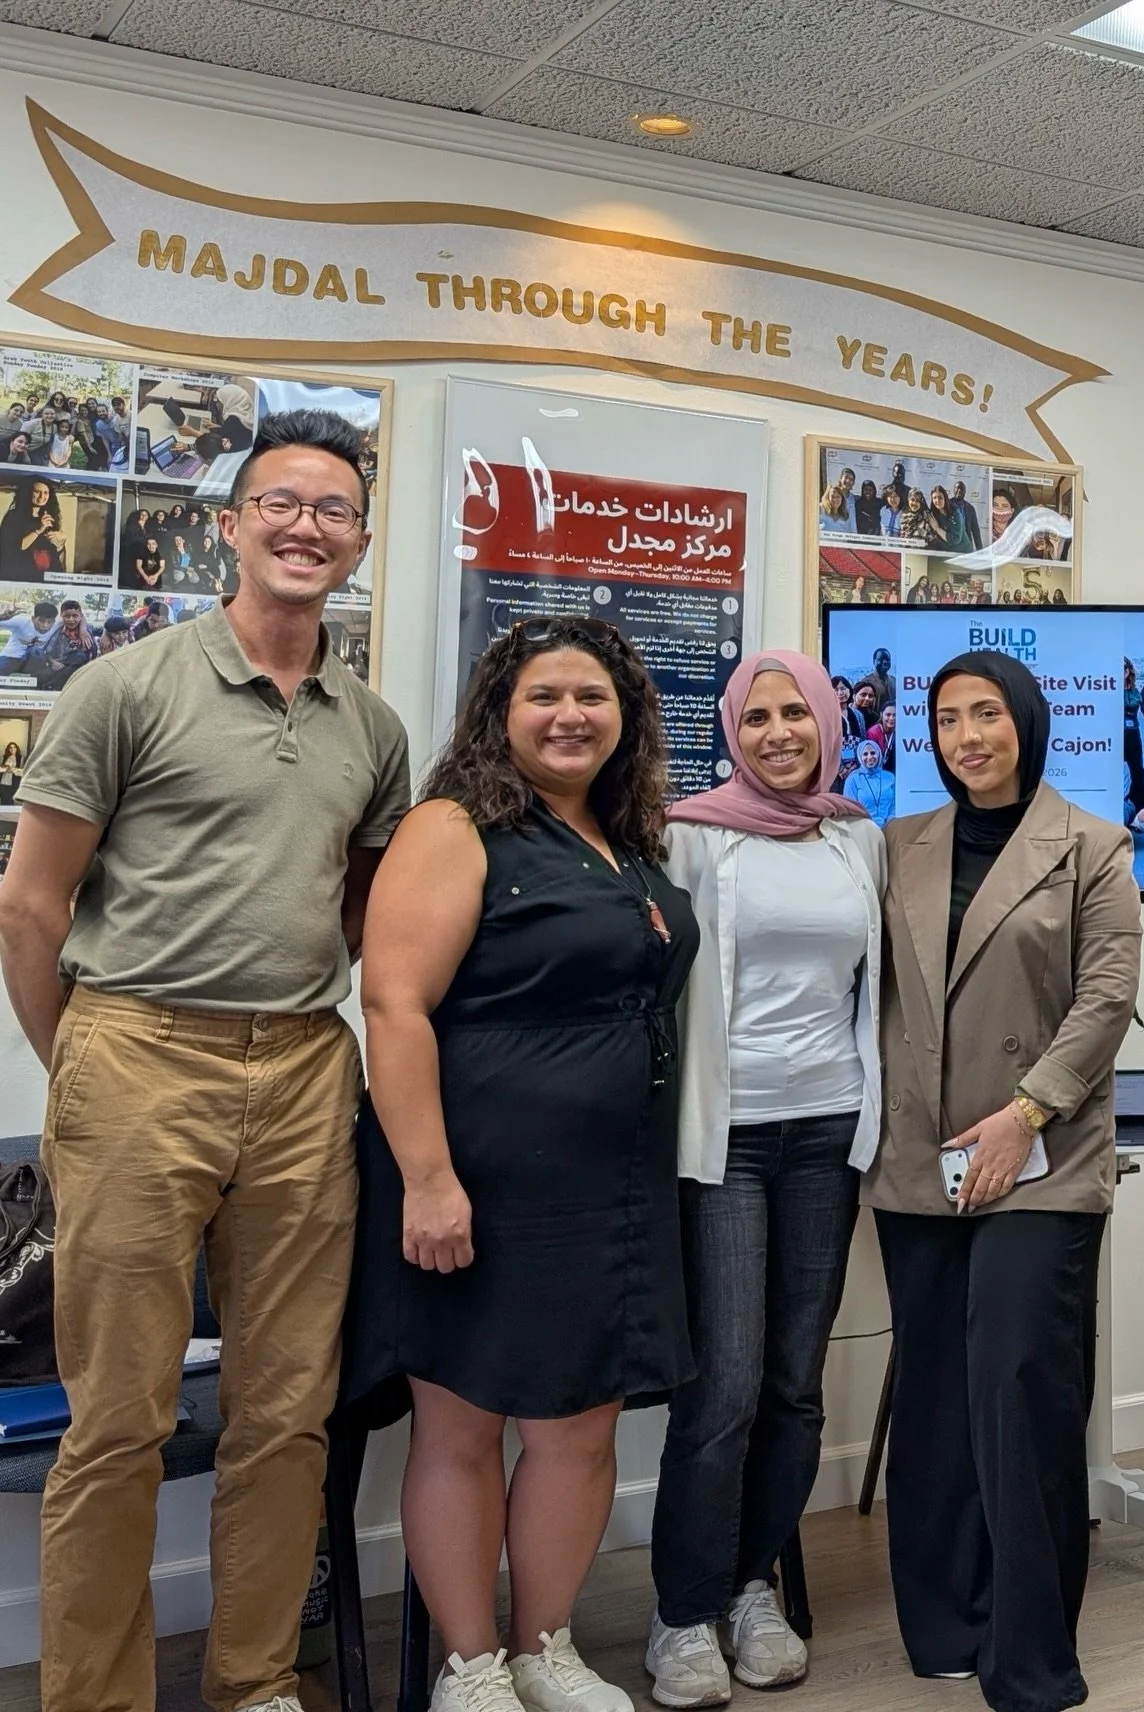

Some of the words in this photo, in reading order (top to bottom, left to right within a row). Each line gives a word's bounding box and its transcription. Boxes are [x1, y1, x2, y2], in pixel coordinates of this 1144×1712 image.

[137, 229, 386, 305] MAJDAL
[415, 272, 666, 337] THROUGH
[702, 310, 792, 358] THE
[836, 335, 994, 413] YEARS!
[635, 501, 732, 534] ارشادات
[608, 526, 676, 557] مجدل
[681, 535, 732, 562] مركز
[588, 566, 606, 575] Open
[969, 628, 1037, 646] BUILD
[903, 676, 933, 690] BU
[1073, 675, 1116, 690] Visit
[903, 700, 926, 716] wi
[1051, 736, 1112, 756] Cajon!
